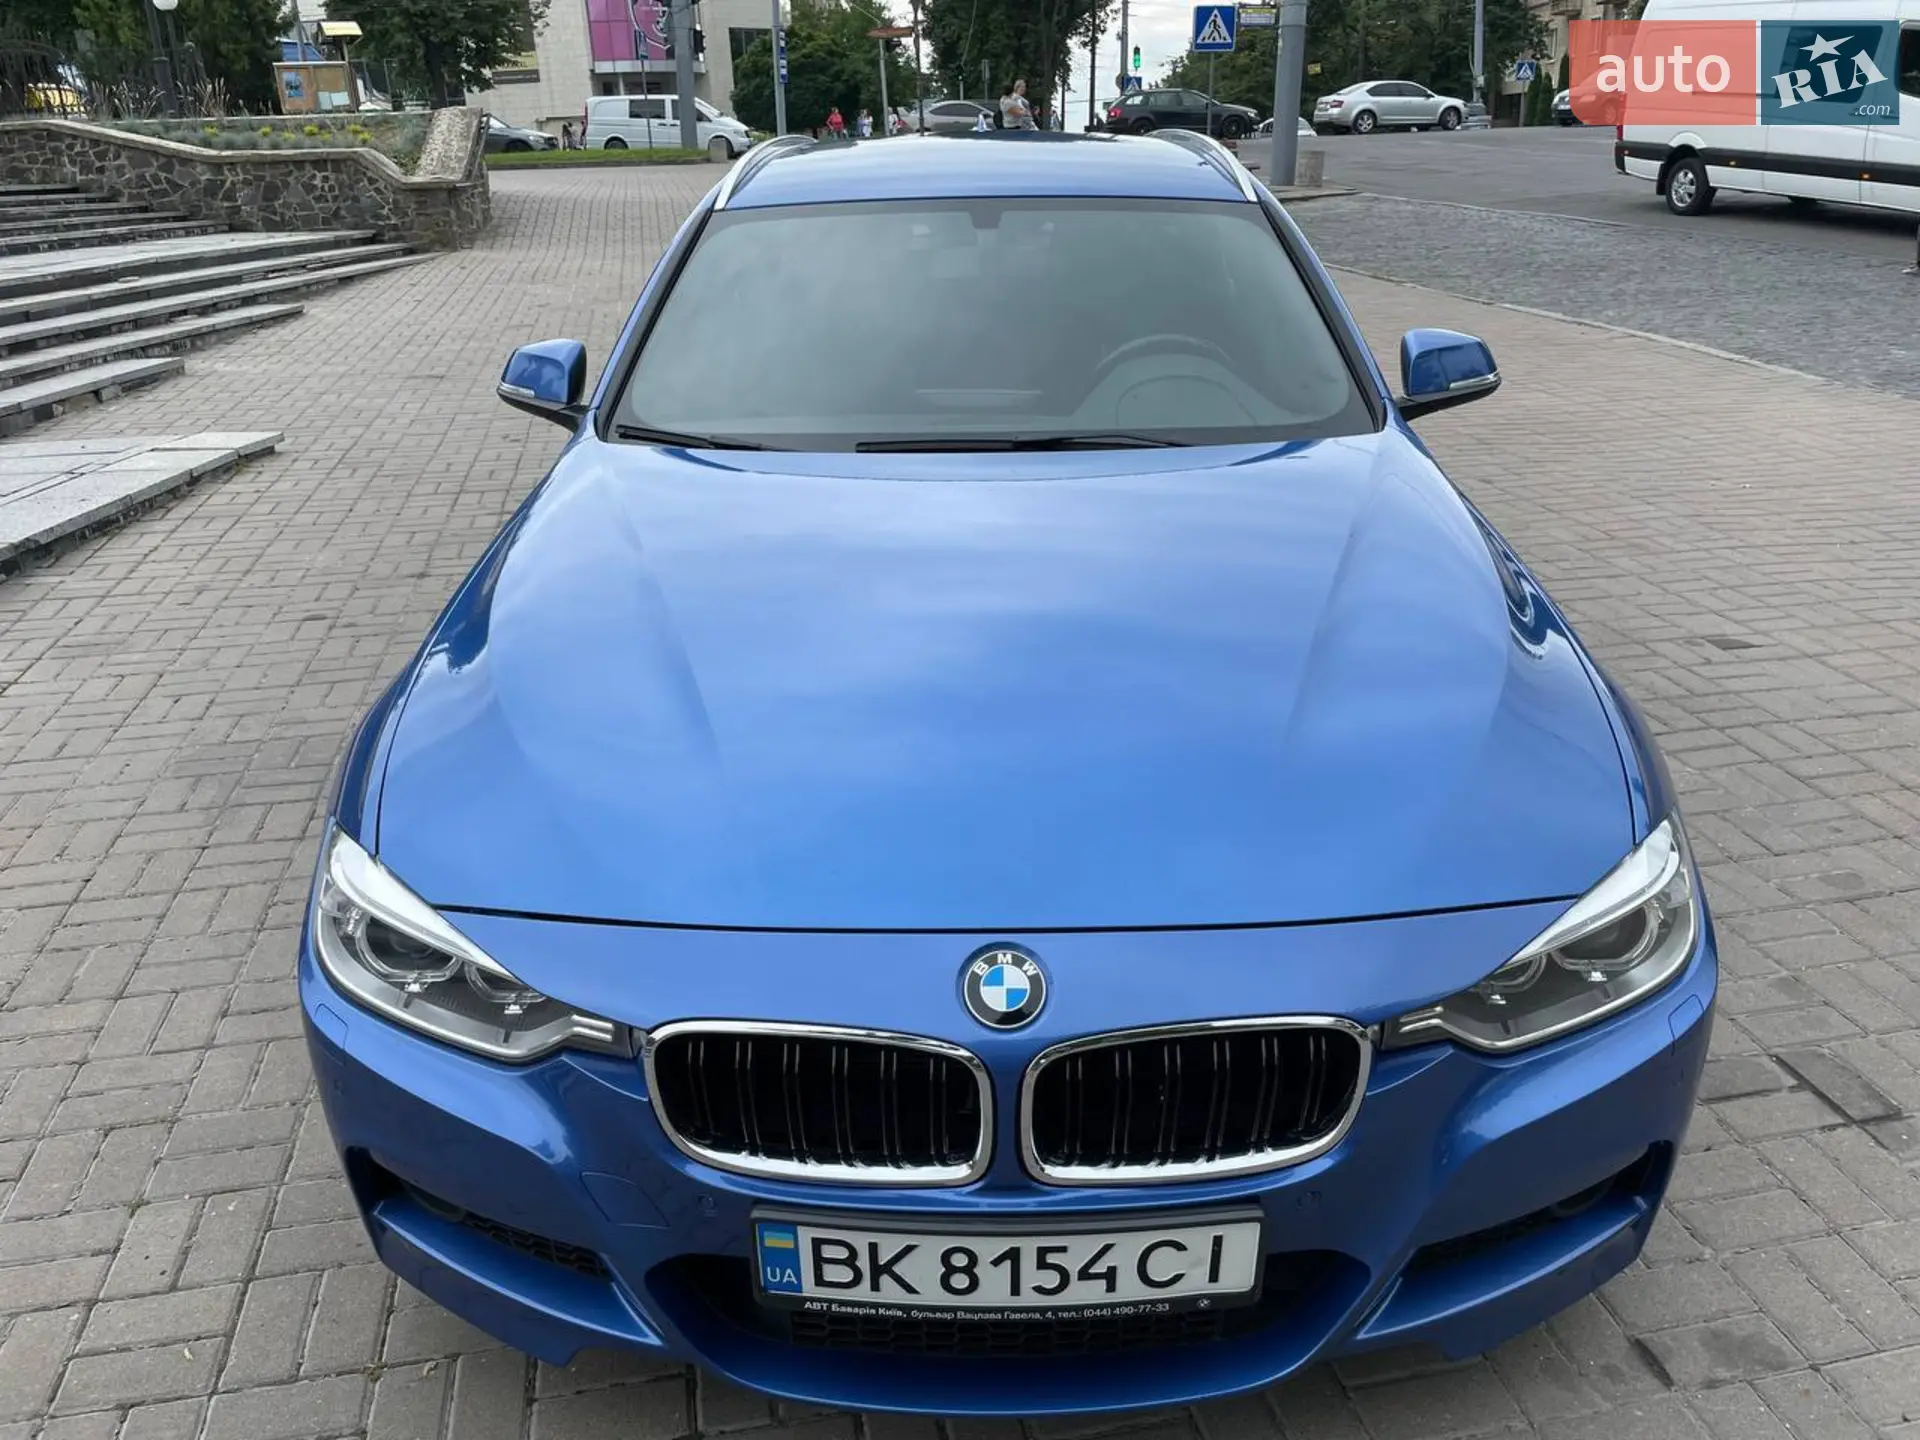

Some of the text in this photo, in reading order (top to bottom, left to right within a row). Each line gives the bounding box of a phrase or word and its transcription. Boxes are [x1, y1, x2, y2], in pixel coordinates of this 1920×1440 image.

[973, 953, 1038, 976] BMW
[767, 1267, 798, 1285] UA
[939, 1243, 1117, 1298] 8154
[910, 1309, 955, 1320] бульвар
[1083, 1307, 1111, 1318] (044)
[1113, 1302, 1170, 1315] 490-77-33
